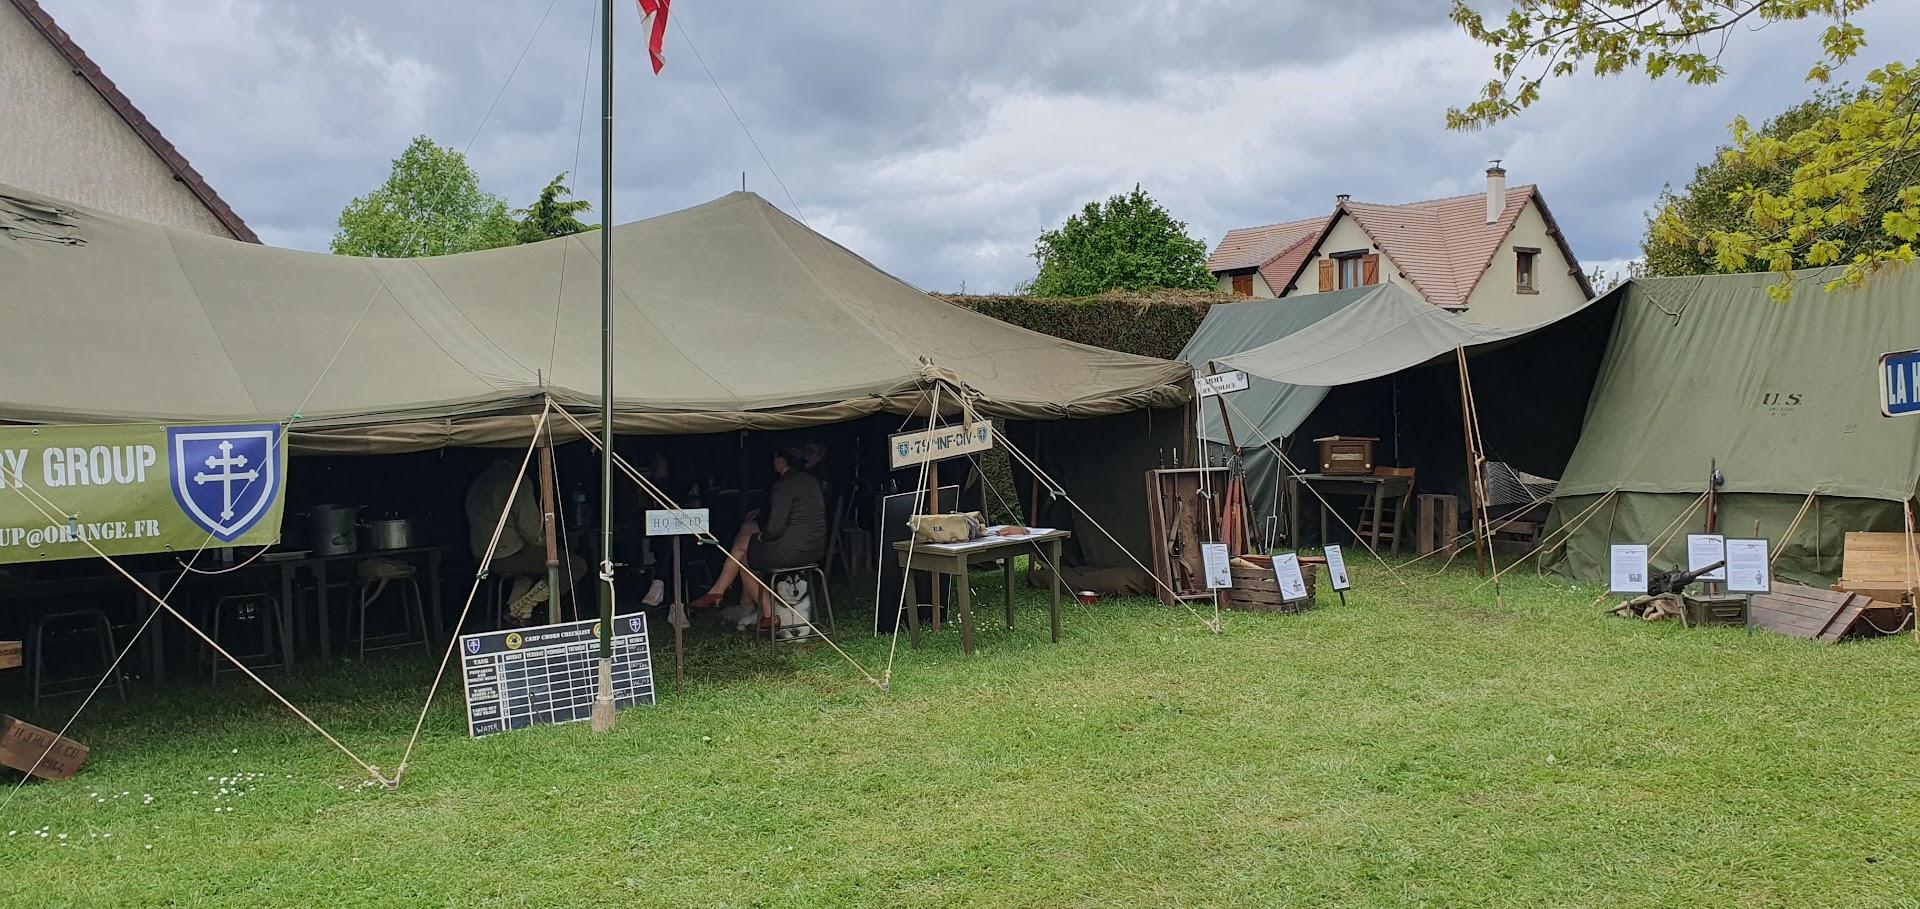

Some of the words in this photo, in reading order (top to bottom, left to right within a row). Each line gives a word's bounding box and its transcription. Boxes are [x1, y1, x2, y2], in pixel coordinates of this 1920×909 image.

[1887, 363, 1908, 405] LA
[42, 444, 157, 488] GROUP
[524, 635, 541, 643] CAMP
[560, 629, 591, 638] CHECKLIST
[475, 723, 500, 733] WATER
